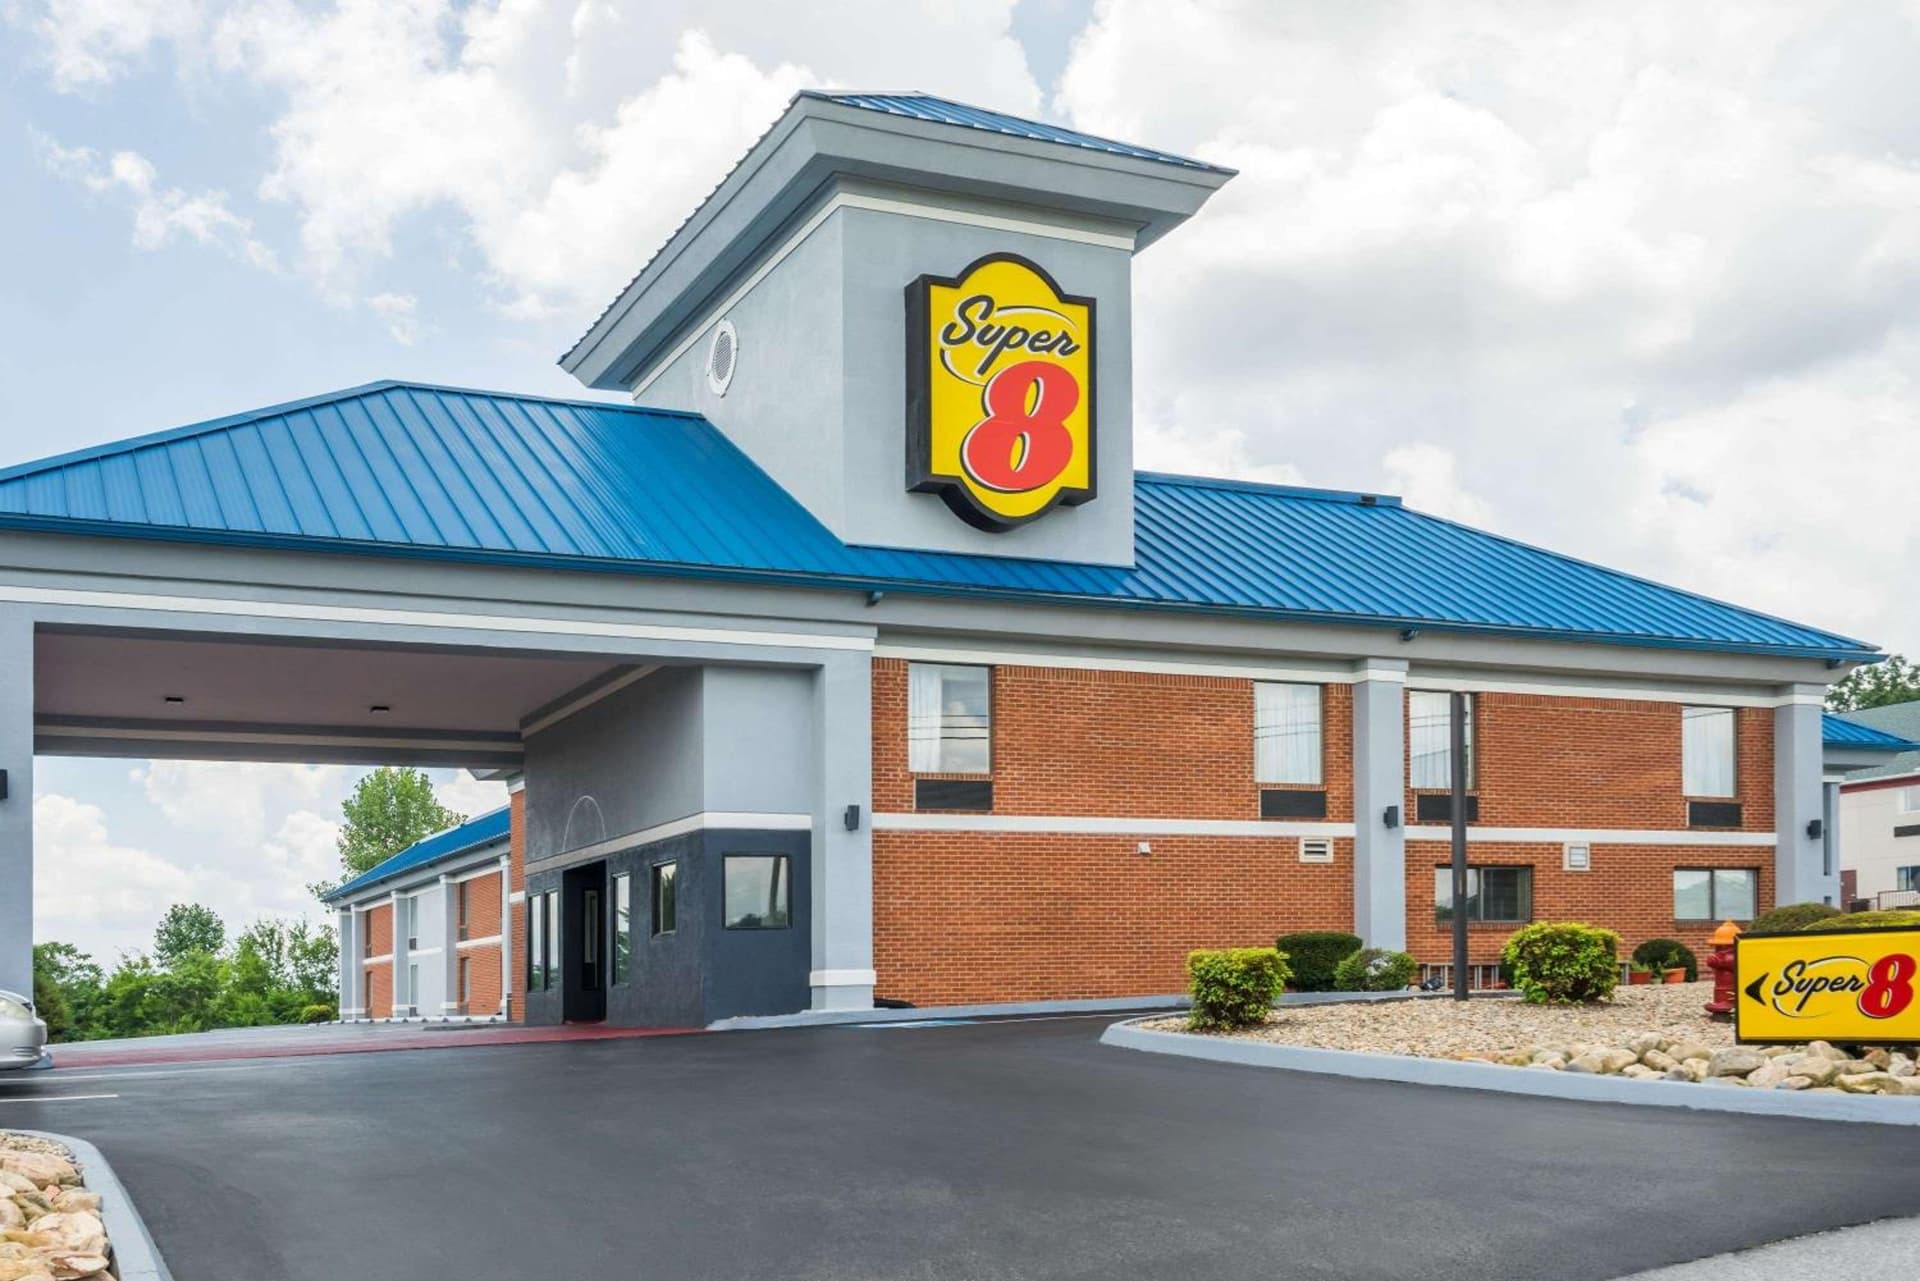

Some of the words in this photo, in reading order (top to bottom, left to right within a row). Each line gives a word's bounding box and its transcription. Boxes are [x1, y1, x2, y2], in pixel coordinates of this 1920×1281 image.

[941, 294, 1081, 377] Super
[960, 360, 1080, 493] 8
[1773, 959, 1865, 1012] Super
[1857, 953, 1917, 1019] 8
